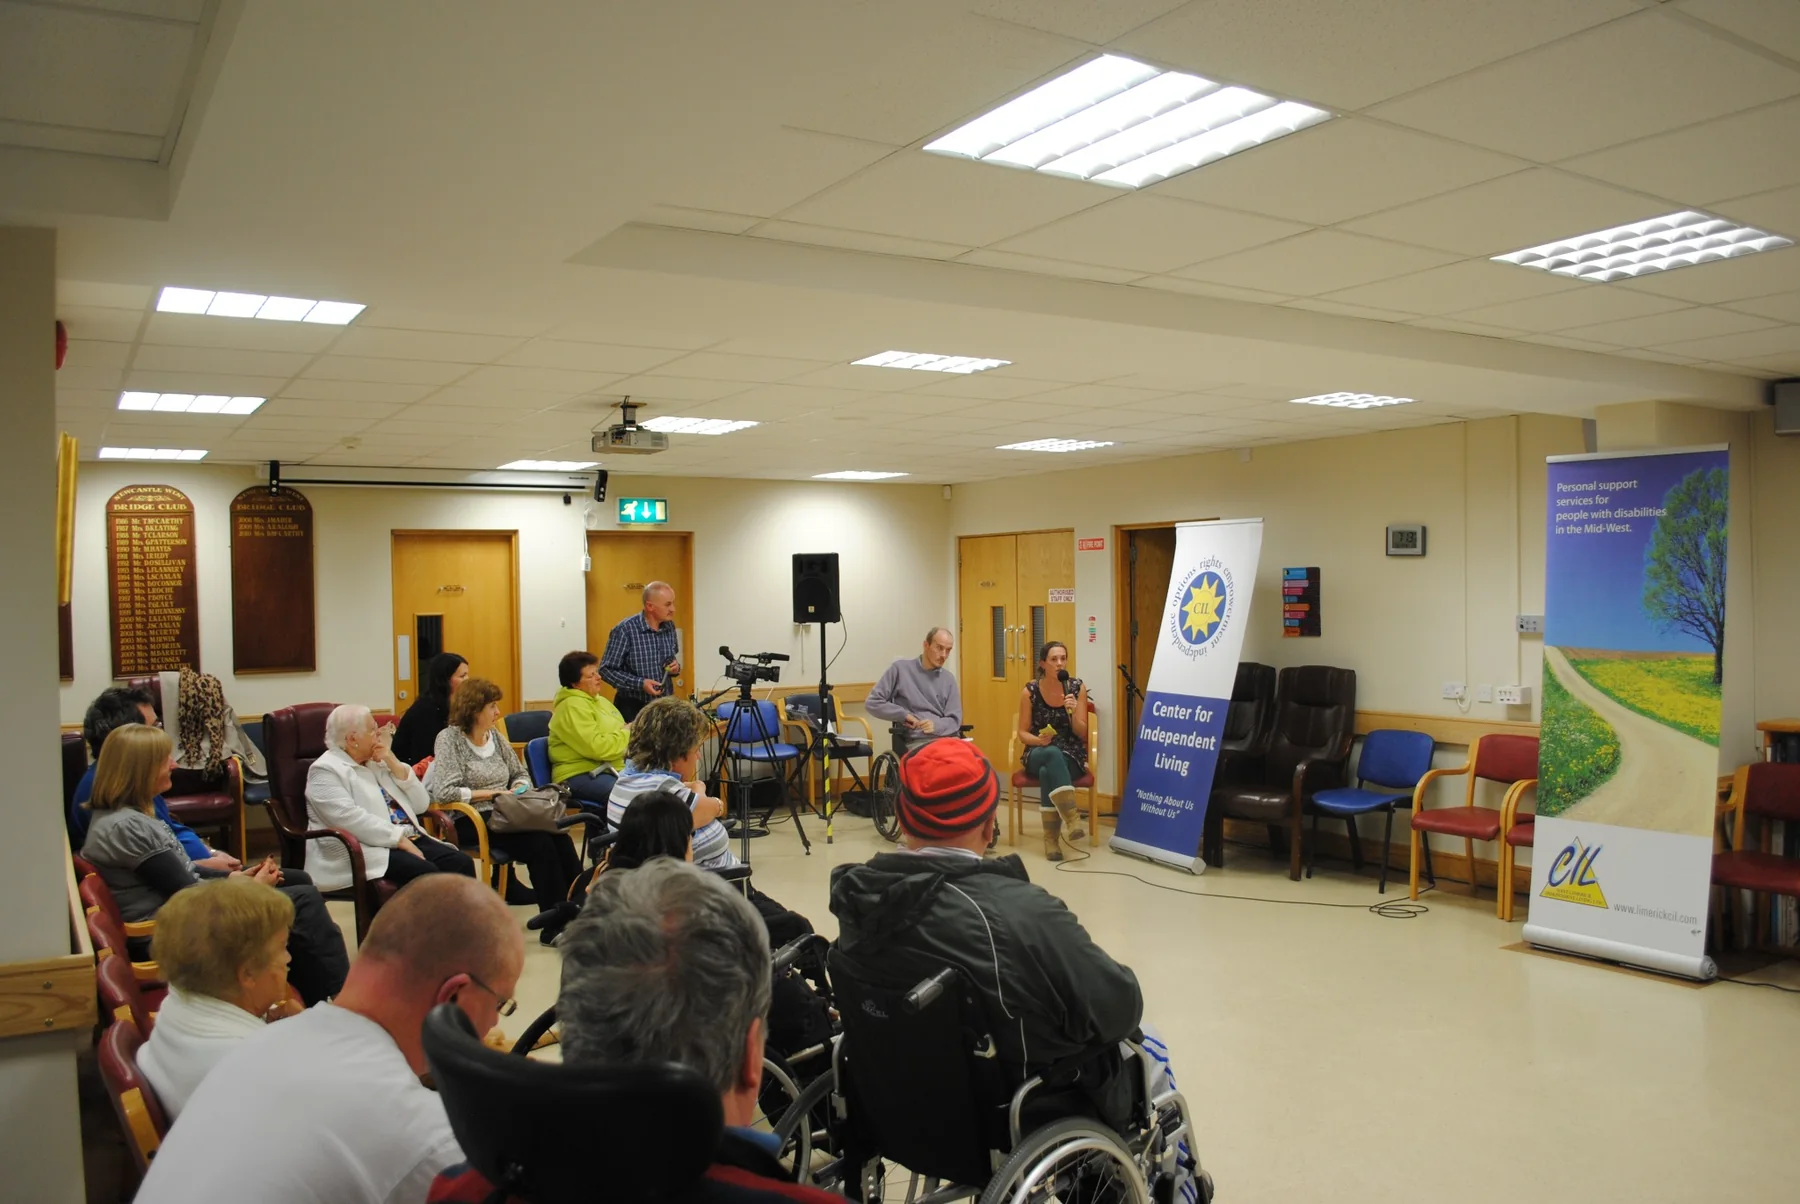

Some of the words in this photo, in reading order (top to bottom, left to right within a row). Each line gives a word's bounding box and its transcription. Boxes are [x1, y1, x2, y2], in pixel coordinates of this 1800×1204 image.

[1557, 481, 1596, 492] Personal
[1598, 480, 1638, 491] support
[113, 487, 163, 501] NEWCASTLE
[165, 488, 186, 500] WEST
[1556, 496, 1593, 506] services
[1595, 495, 1609, 504] for
[236, 503, 275, 511] BRIDGE
[1556, 510, 1589, 522] people
[1591, 509, 1612, 519] with
[1614, 507, 1667, 518] disabilities
[1555, 525, 1564, 534] in
[1566, 525, 1582, 534] the
[1584, 523, 1632, 533] Mid-West.
[1200, 555, 1222, 571] rights
[1173, 567, 1196, 607] options
[1193, 603, 1210, 615] CIL
[1211, 568, 1235, 648] empowerment
[1170, 613, 1207, 661] independence
[1152, 701, 1192, 720] Center
[1195, 705, 1213, 723] for
[1140, 724, 1216, 750] Independent
[1154, 752, 1190, 776] Living
[1140, 802, 1166, 817] Without
[1163, 796, 1185, 808] About
[1184, 800, 1194, 810] Us
[1549, 846, 1601, 887] CIL
[1613, 904, 1697, 924] www.limerickcil.com
